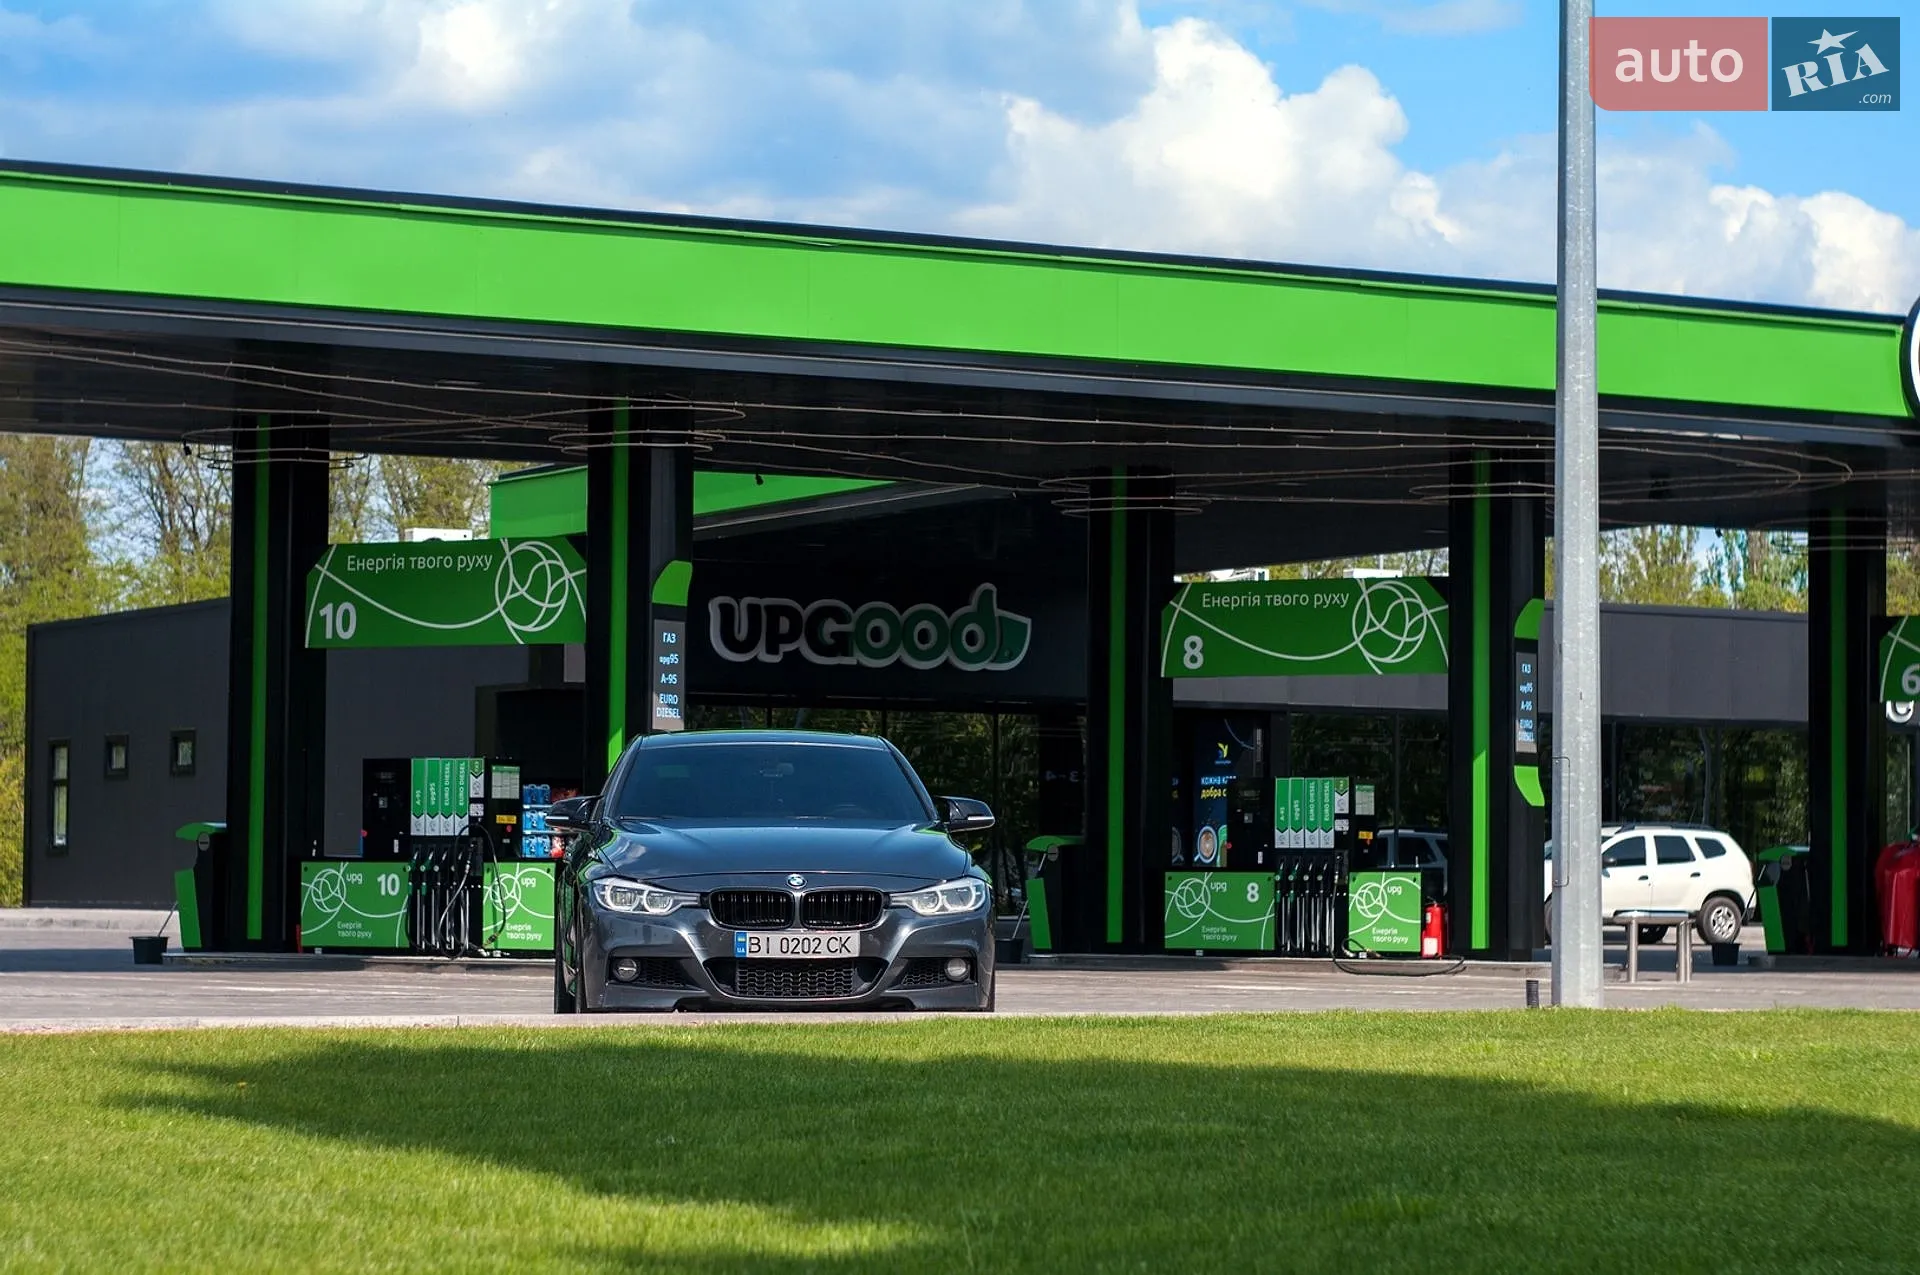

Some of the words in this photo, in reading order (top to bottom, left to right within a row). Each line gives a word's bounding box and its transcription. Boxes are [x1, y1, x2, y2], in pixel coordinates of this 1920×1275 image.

[347, 554, 405, 574] Енергія
[409, 556, 453, 570] твого
[457, 552, 493, 572] руху
[1202, 591, 1261, 610] Енергія
[1265, 593, 1309, 606] твого
[1314, 591, 1350, 608] руху
[319, 602, 357, 639] 10
[662, 632, 677, 644] ГАЗ
[1183, 635, 1204, 670] 8
[1902, 663, 1920, 695] 6
[659, 694, 678, 704] EURO
[656, 707, 681, 719] DIESEL
[346, 872, 363, 885] upg
[377, 874, 400, 896] 10
[521, 876, 536, 888] upg
[1210, 880, 1227, 892] upg
[1246, 882, 1259, 902] 8
[1387, 884, 1402, 896] upg
[748, 937, 770, 954] BI
[780, 937, 822, 954] 0202
[826, 936, 852, 954] CK
